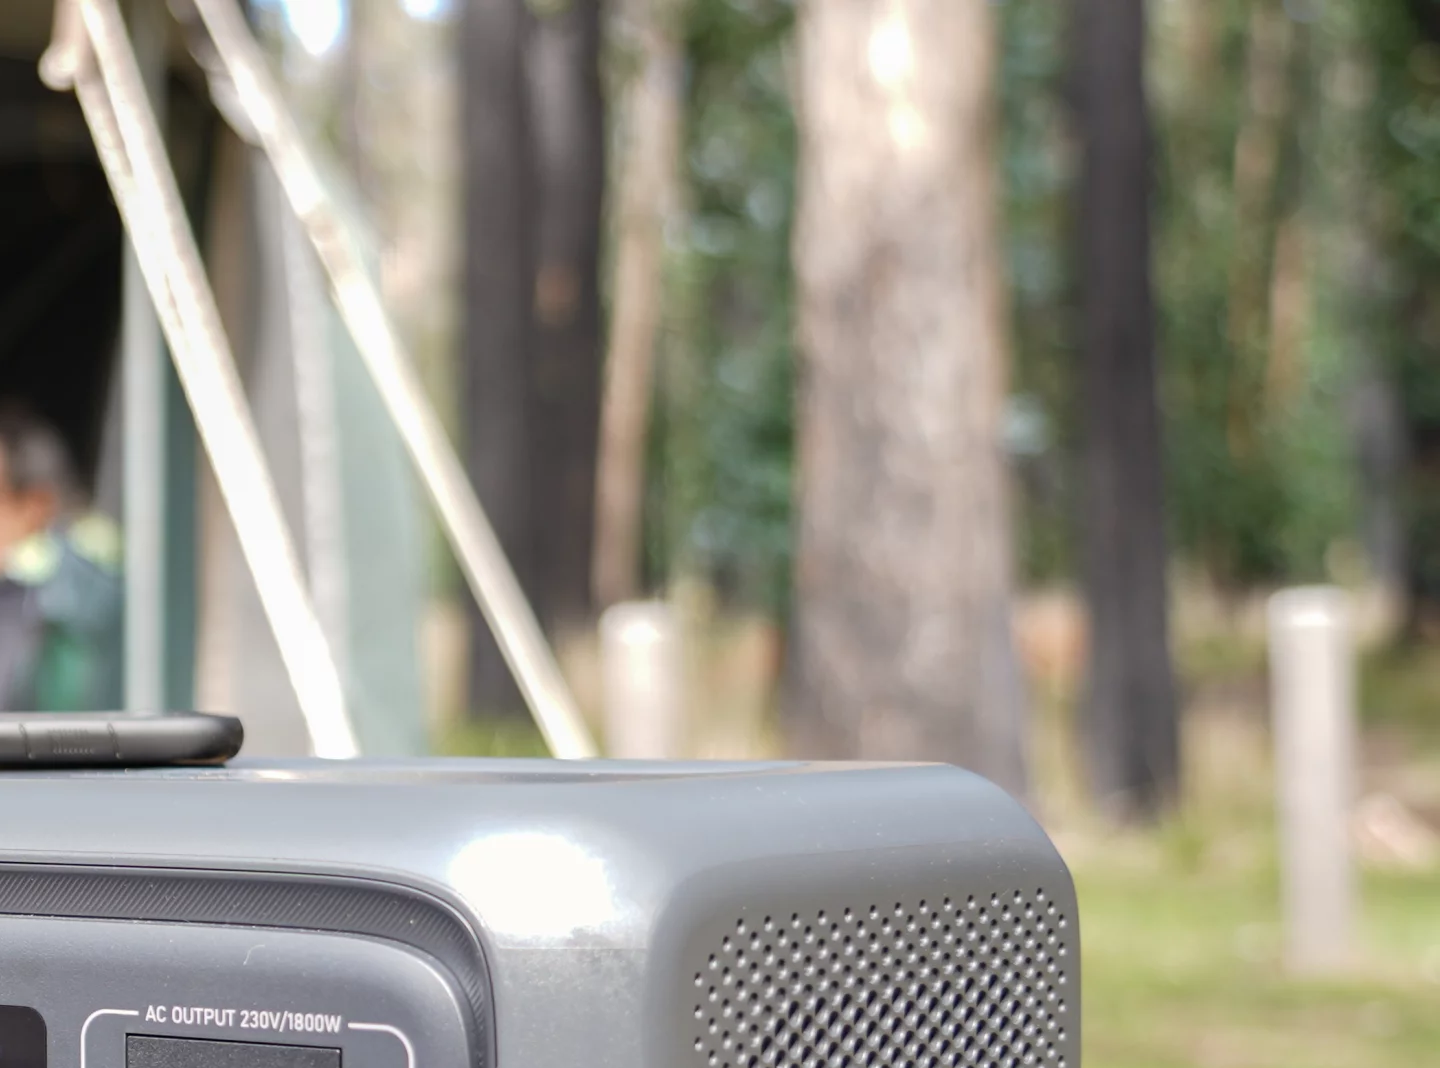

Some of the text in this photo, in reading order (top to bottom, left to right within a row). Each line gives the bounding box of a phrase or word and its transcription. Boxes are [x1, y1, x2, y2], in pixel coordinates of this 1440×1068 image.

[145, 1005, 341, 1033] AC OUTPUT 230V/1800W
